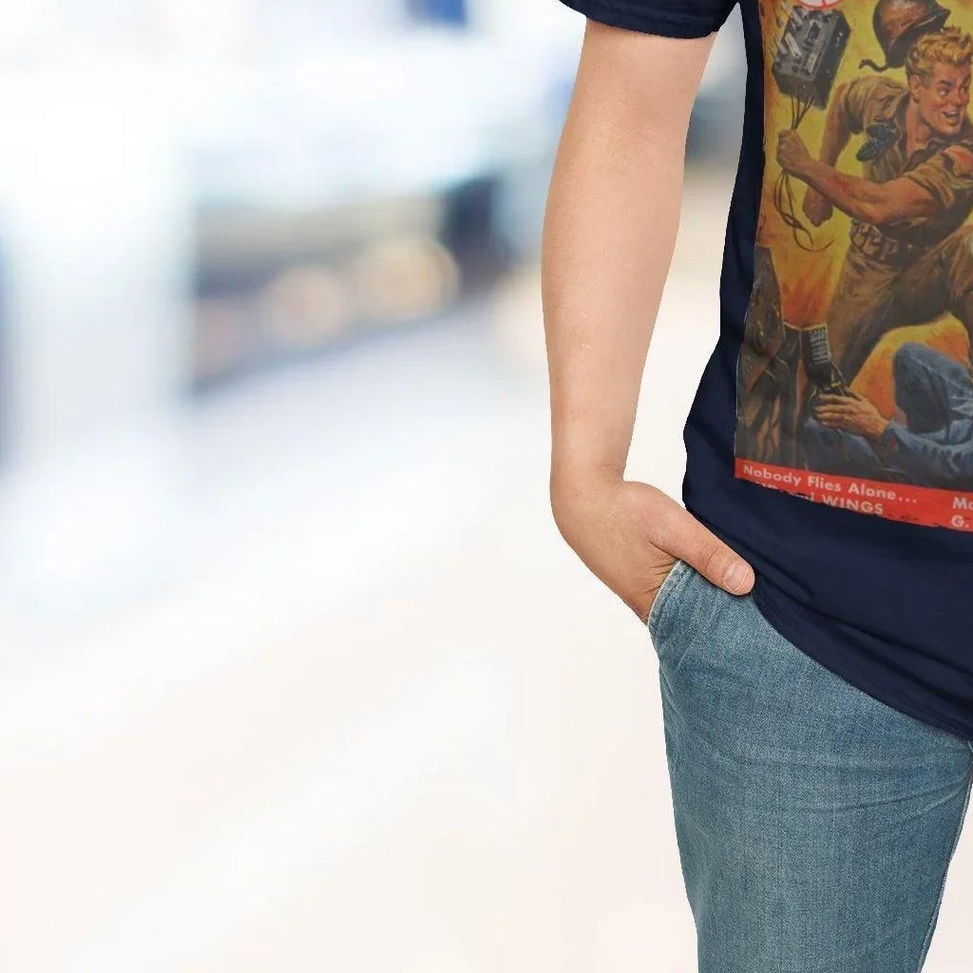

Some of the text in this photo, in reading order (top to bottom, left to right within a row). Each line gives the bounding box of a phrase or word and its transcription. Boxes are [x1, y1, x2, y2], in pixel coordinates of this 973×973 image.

[743, 464, 801, 486] Nobody
[807, 475, 841, 492] Flies
[847, 482, 917, 504] Alone...
[821, 493, 884, 515] WINGS
